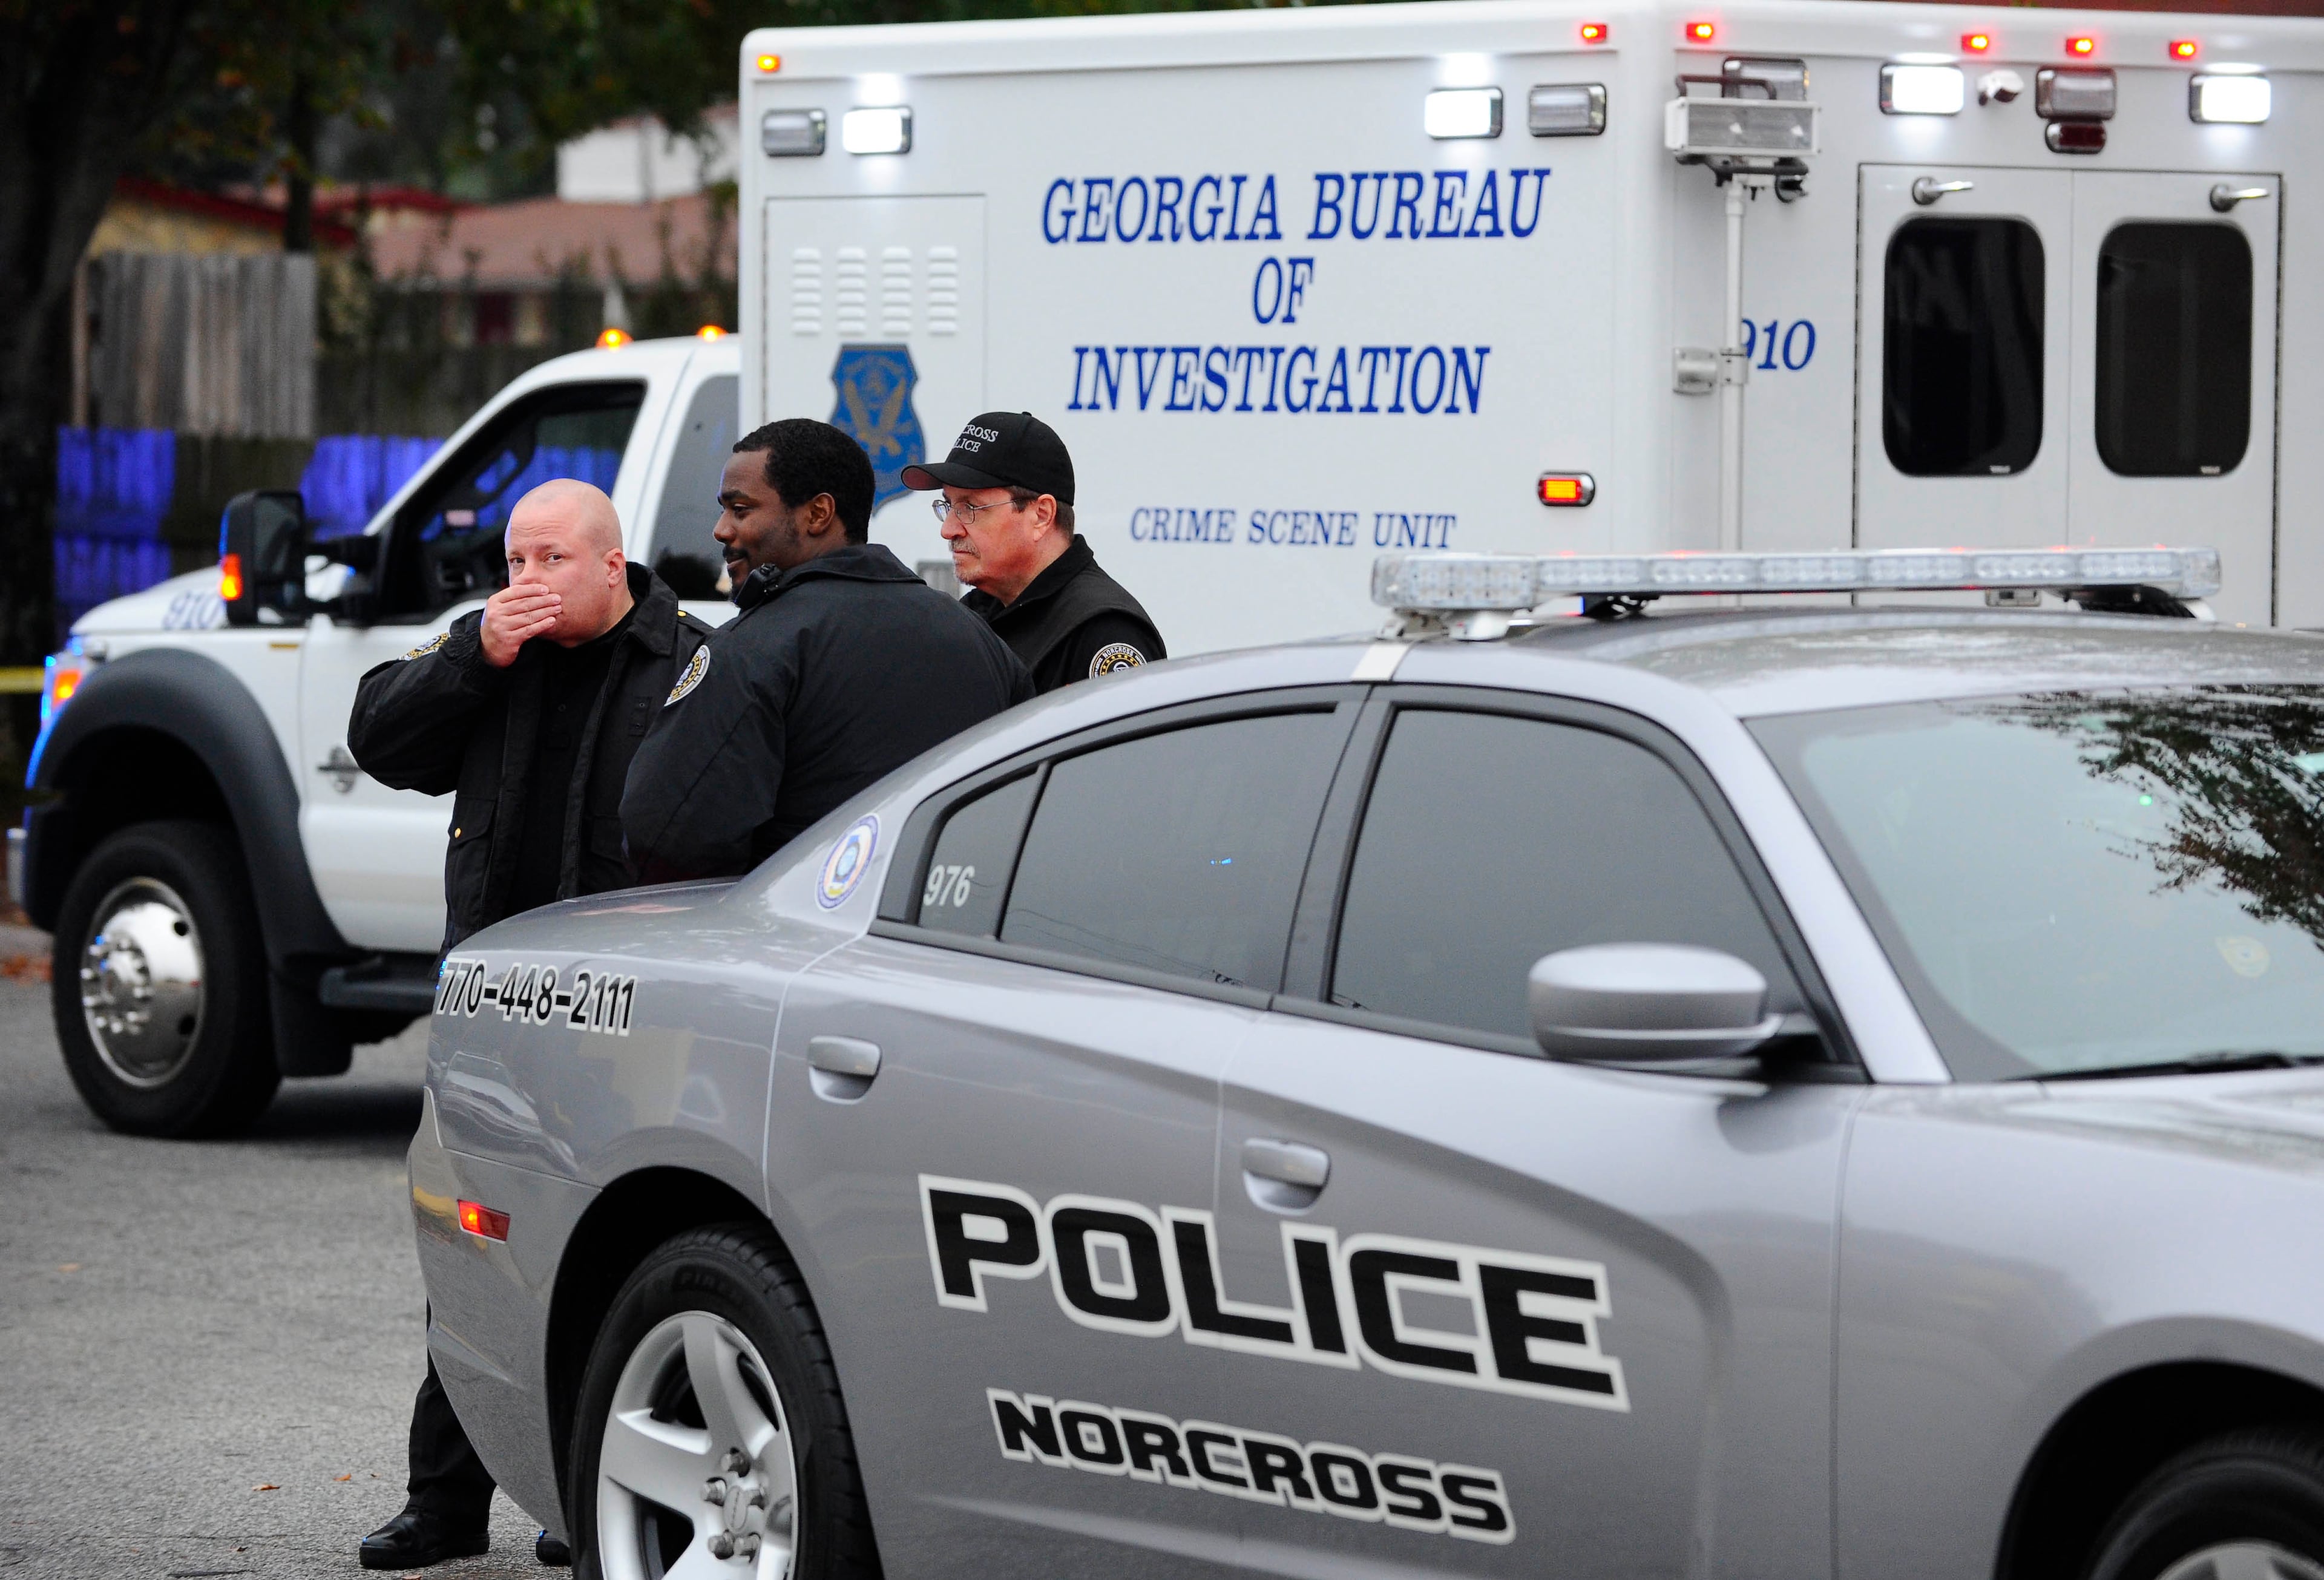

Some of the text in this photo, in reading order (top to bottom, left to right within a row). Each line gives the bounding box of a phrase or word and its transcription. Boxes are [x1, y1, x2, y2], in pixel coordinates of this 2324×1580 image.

[1042, 168, 1551, 245] GEORGIA BUREAU
[1253, 256, 1315, 325] OF
[1067, 345, 1491, 415] INVESTIGATION
[1130, 506, 1457, 550] CRIME SCENE UNIT
[163, 590, 222, 629] 910
[1102, 647, 1134, 658] NORCROSS
[923, 864, 975, 907] 976
[436, 958, 637, 1036] 770-448-2111
[920, 1175, 1629, 1411] POLICE
[986, 1388, 1516, 1543] NORCROSS
